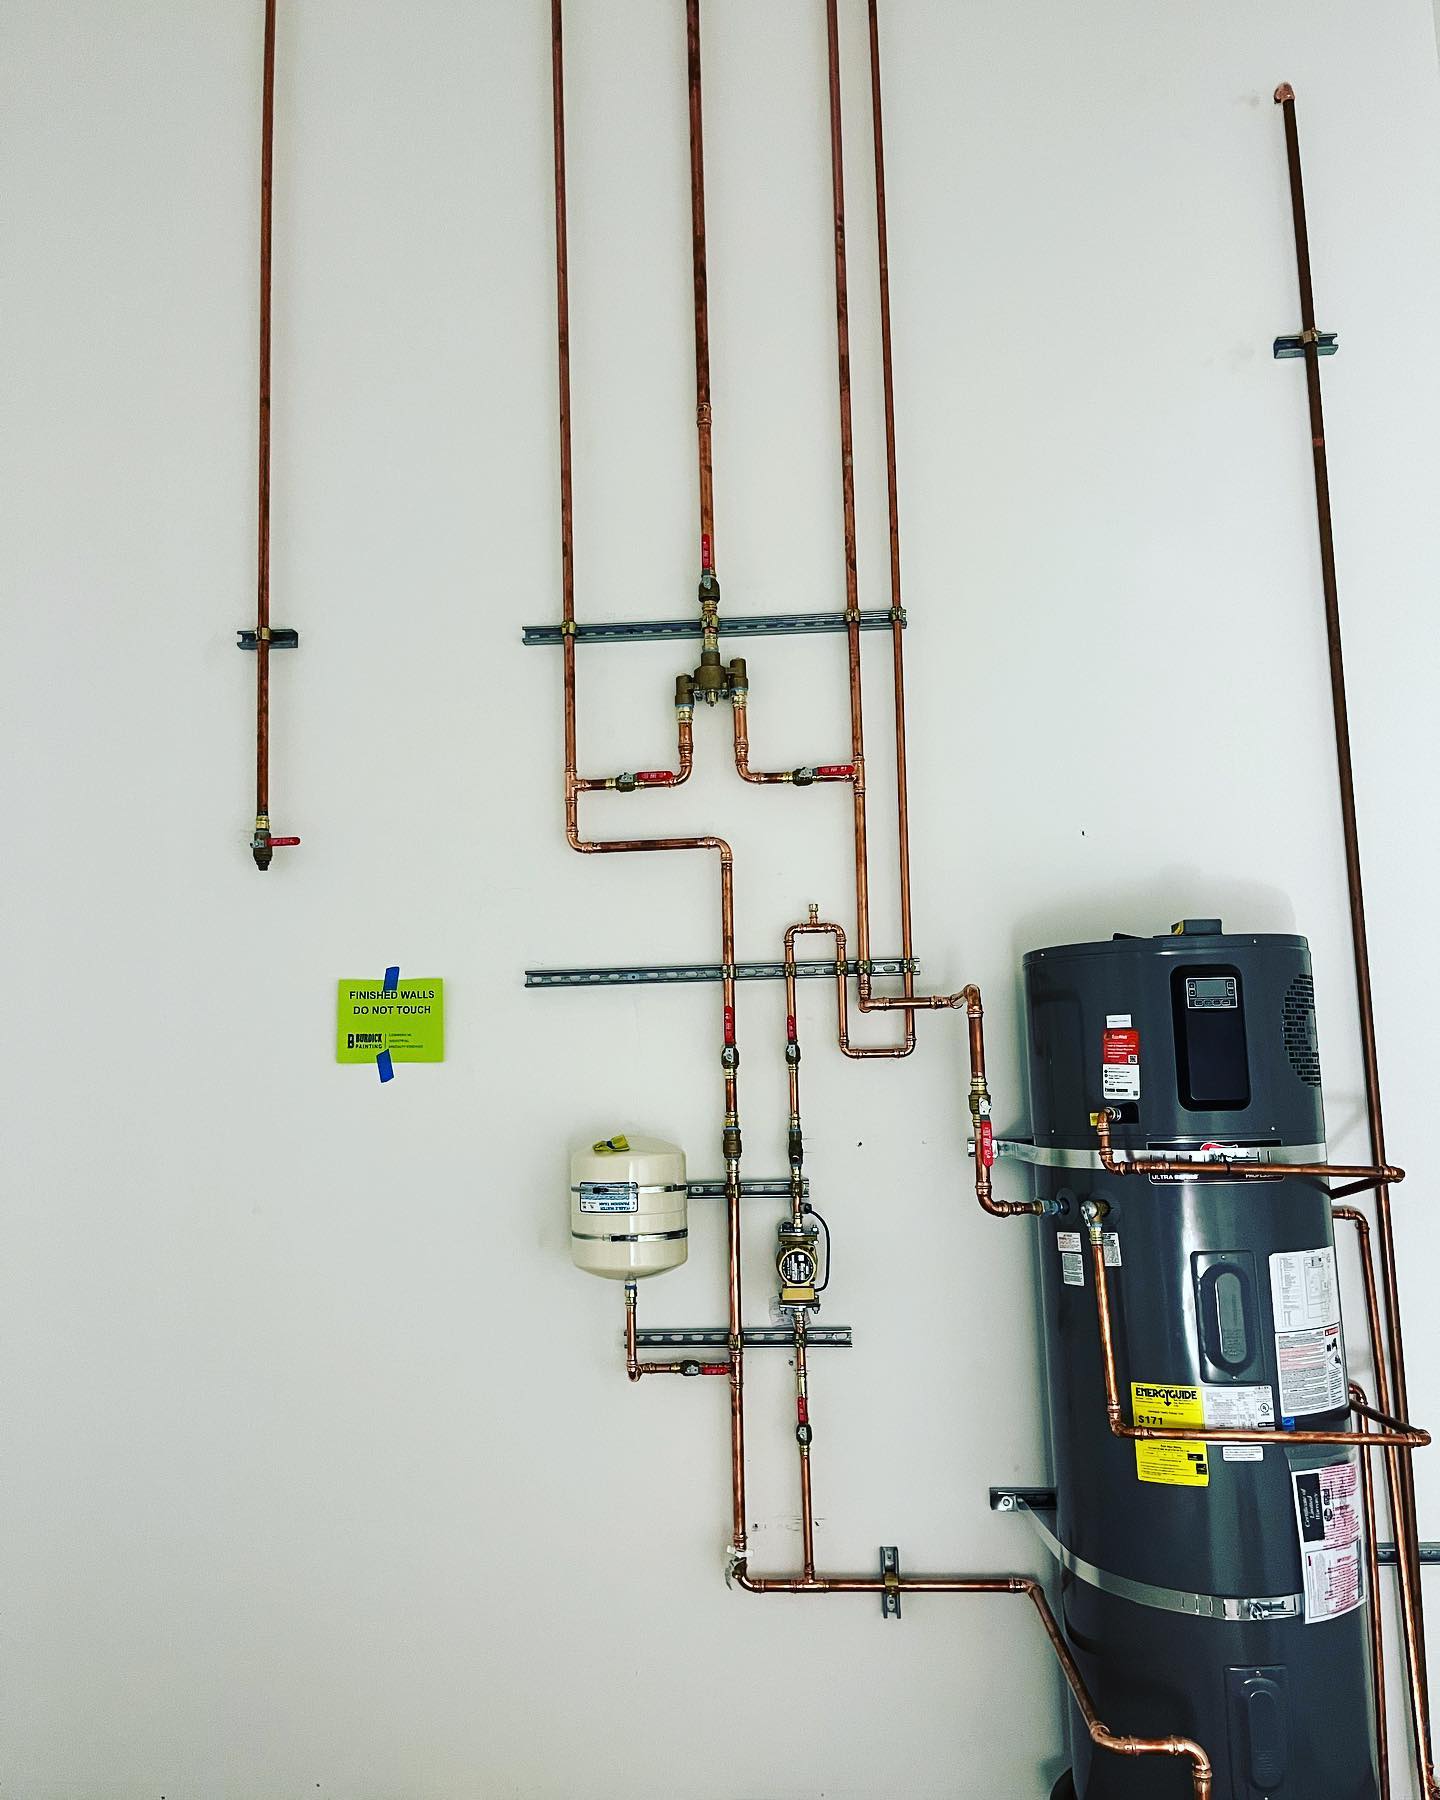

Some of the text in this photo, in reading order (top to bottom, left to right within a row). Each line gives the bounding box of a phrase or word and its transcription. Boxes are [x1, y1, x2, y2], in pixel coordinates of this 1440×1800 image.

[349, 990, 435, 999] FINISHED WALLS
[353, 1005, 431, 1015] DO NOT TOUCH
[1135, 1387, 1198, 1400] ENERGYGUIDE
